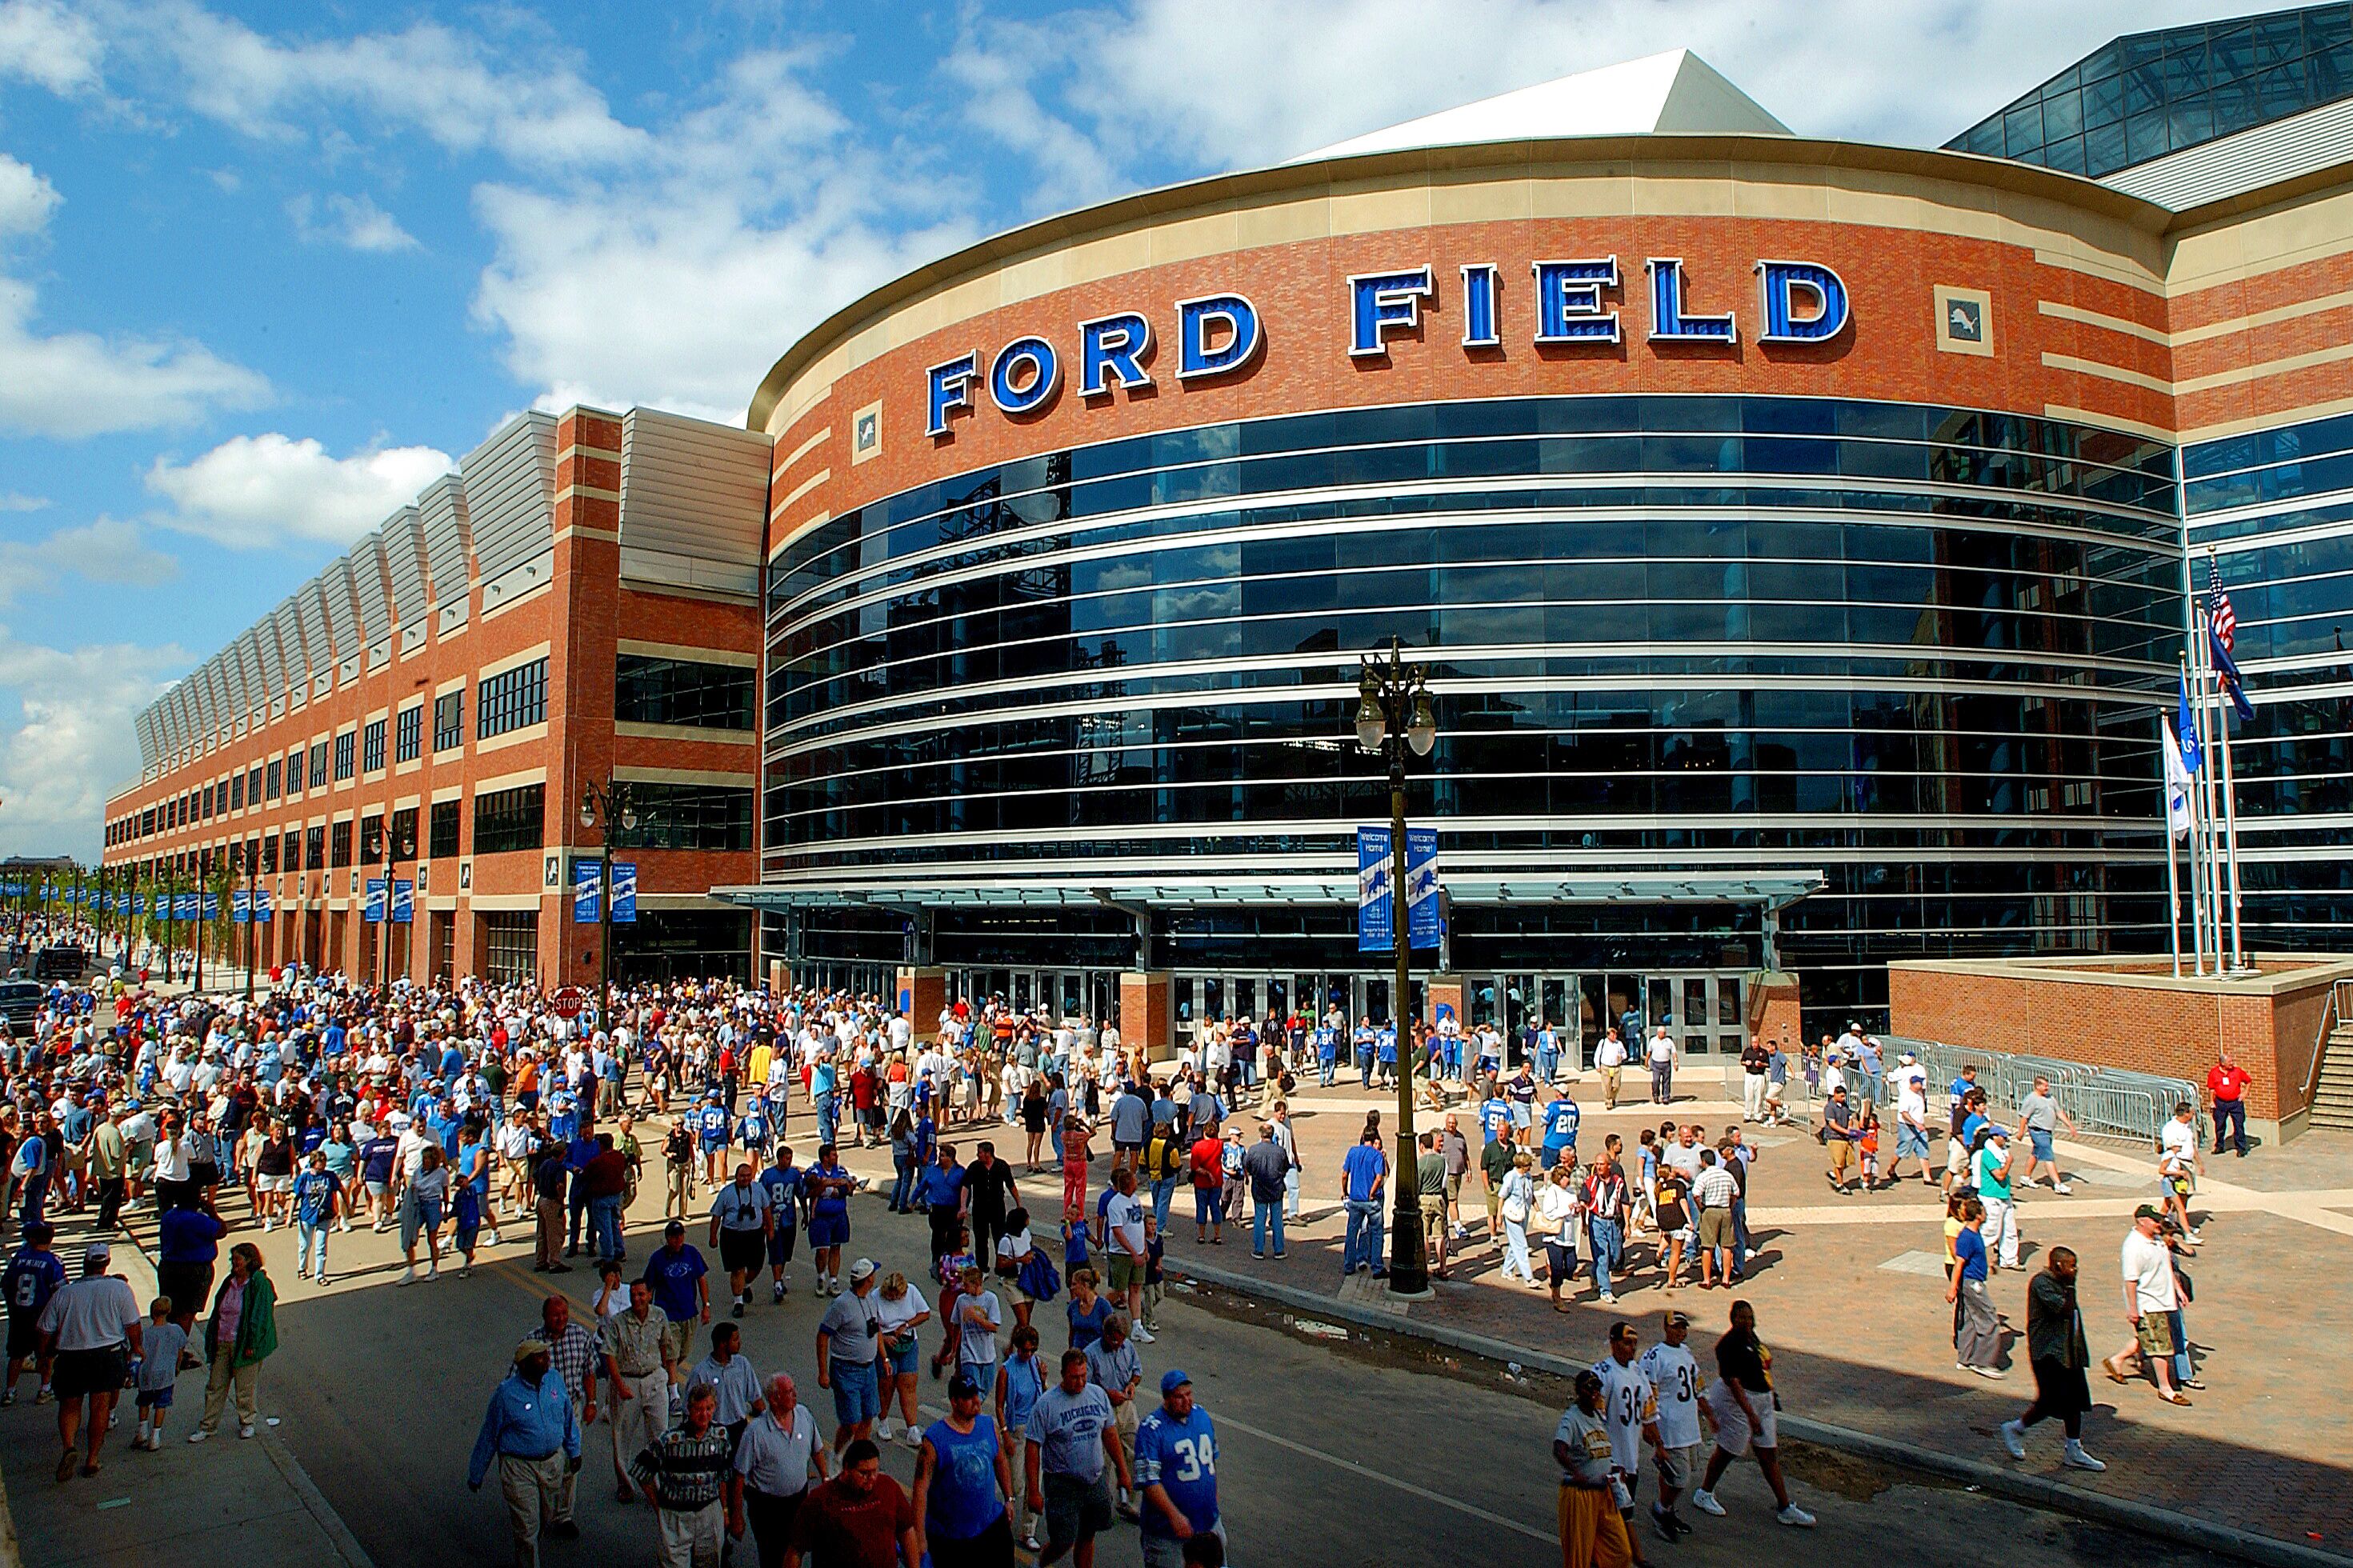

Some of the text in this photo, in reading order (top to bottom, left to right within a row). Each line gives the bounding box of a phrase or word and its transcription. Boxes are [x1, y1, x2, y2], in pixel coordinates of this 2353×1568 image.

[925, 254, 1851, 437] FORD FIELD
[1360, 832, 1388, 842] Welcome
[1409, 834, 1435, 842] Welcome
[555, 997, 582, 1010] STOP
[1322, 1033, 1334, 1046] 84
[307, 1040, 315, 1054] 2
[1555, 1114, 1576, 1134] 20
[772, 1182, 794, 1203] 84
[1174, 1434, 1215, 1482] 34
